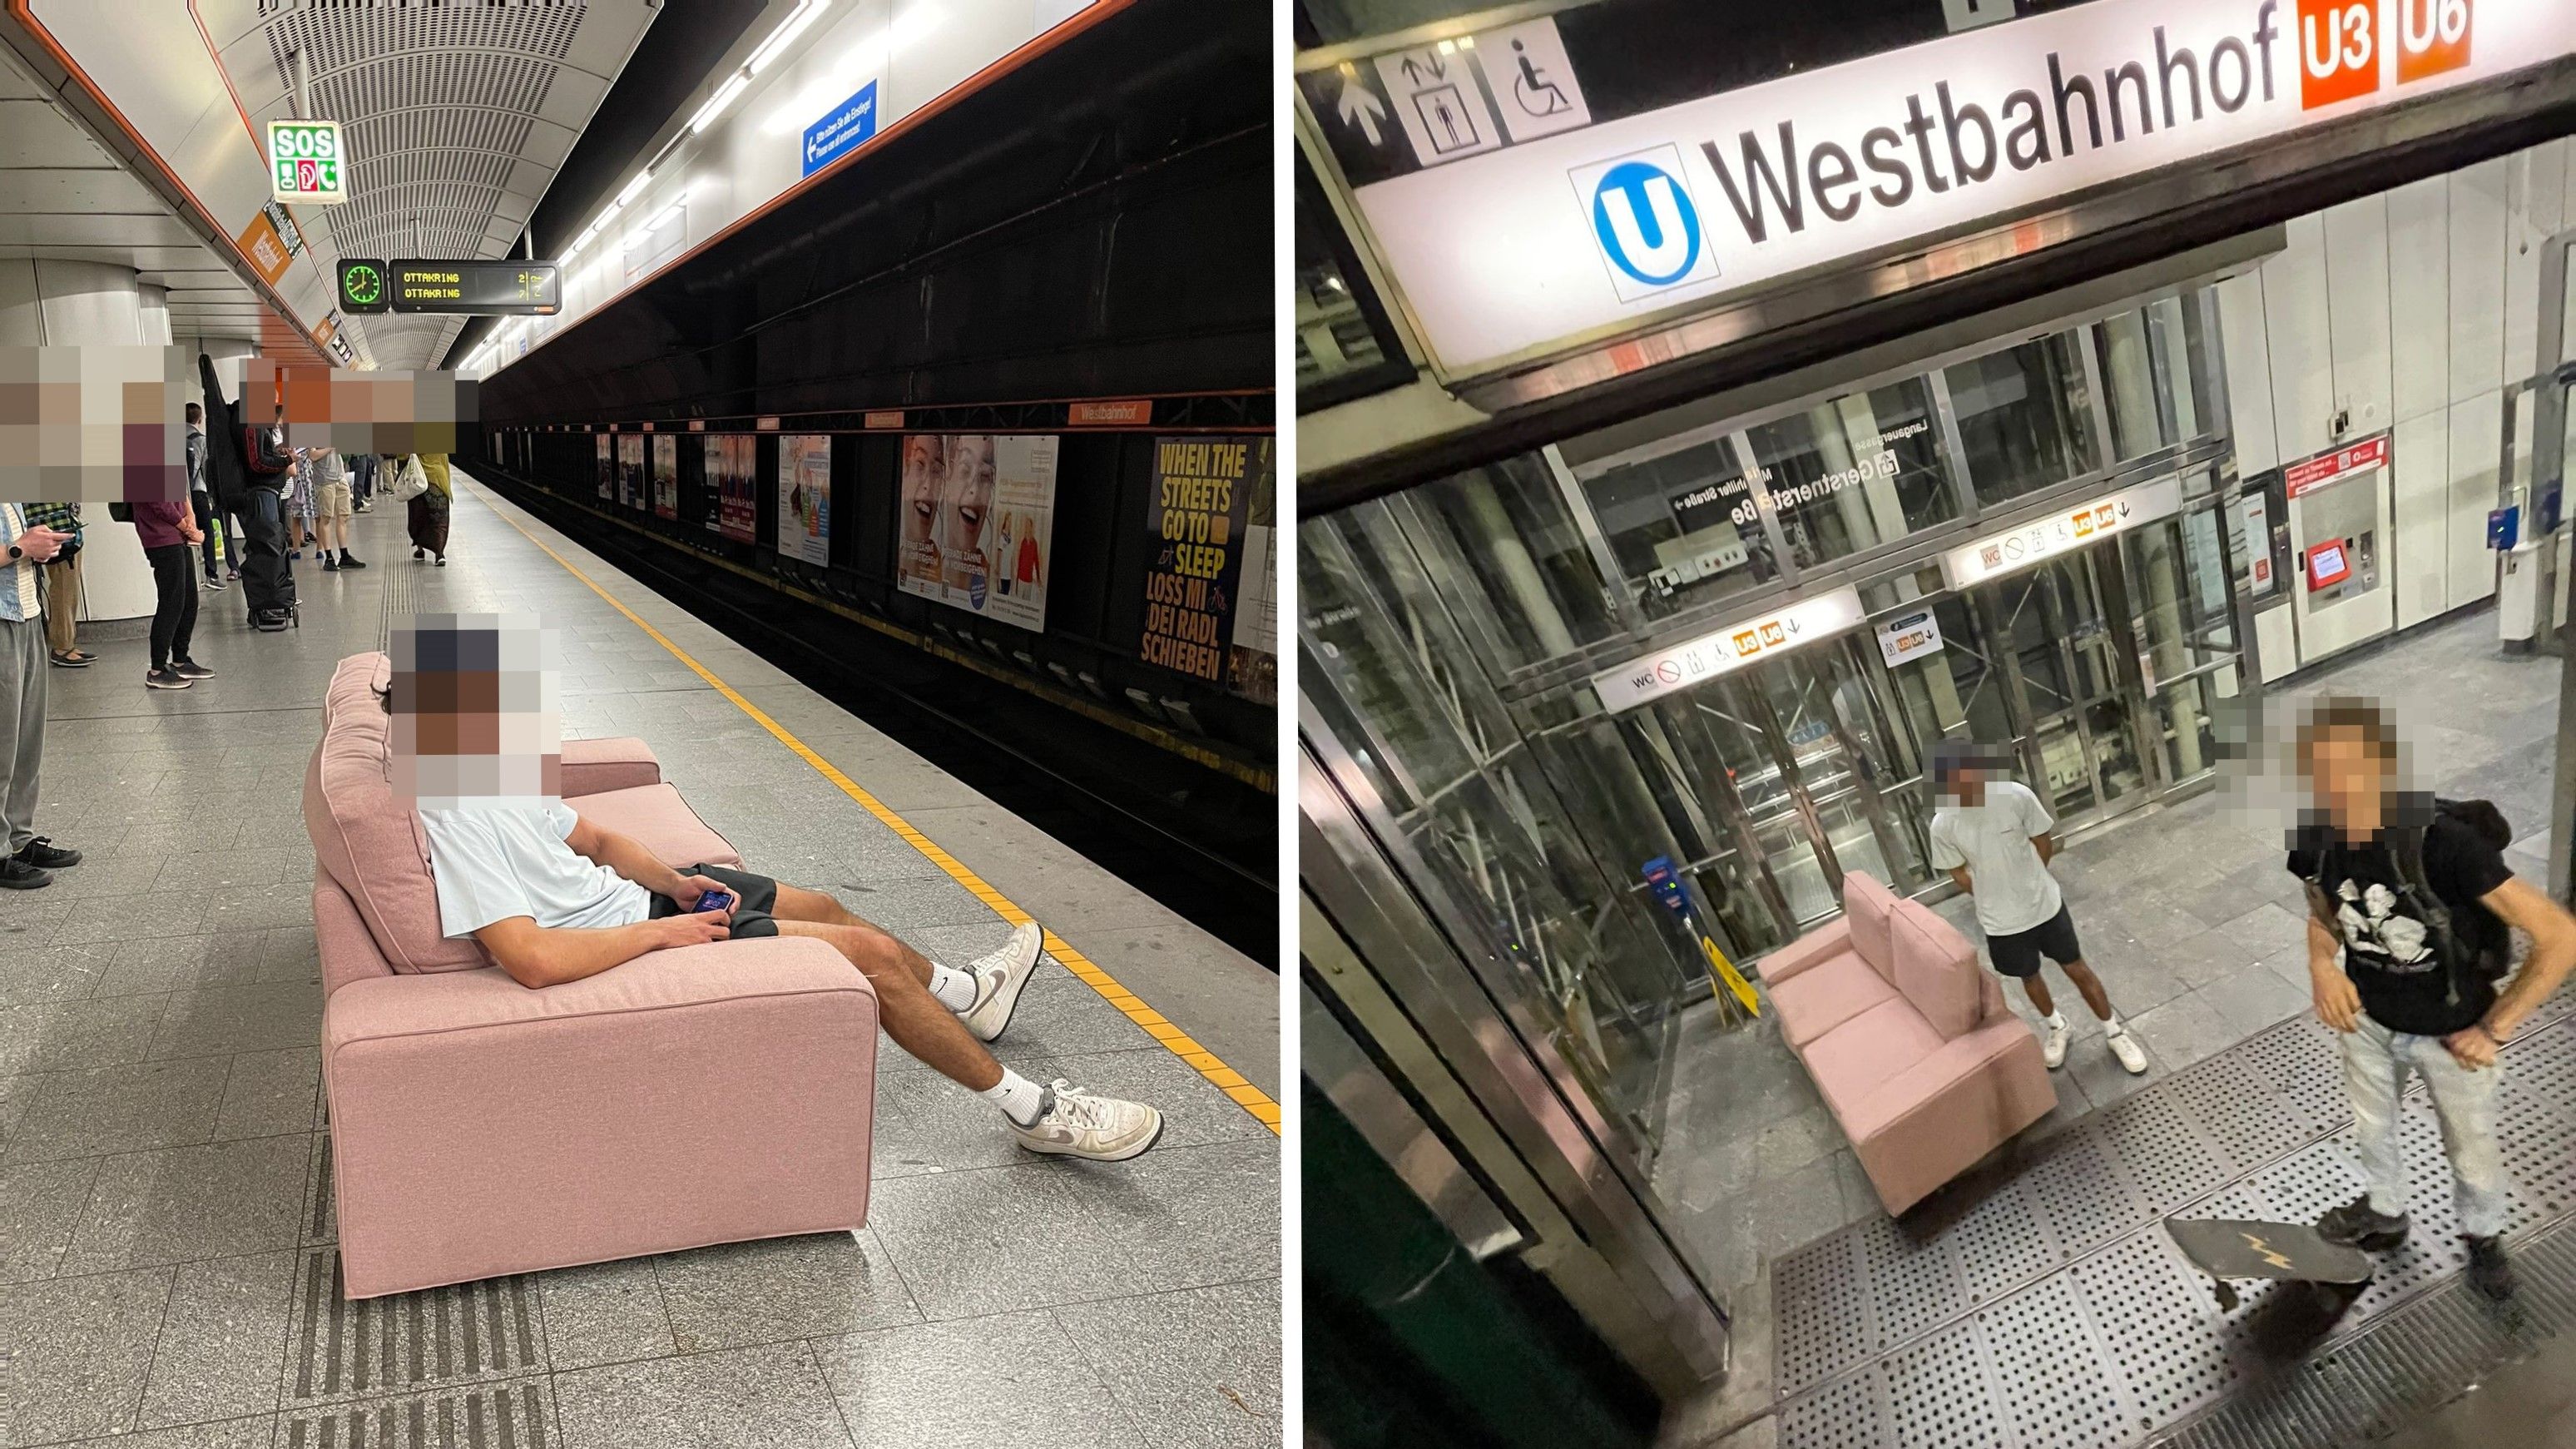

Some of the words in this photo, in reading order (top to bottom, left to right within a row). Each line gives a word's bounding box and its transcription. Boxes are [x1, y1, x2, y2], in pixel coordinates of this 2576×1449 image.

[276, 128, 334, 157] SOS
[1599, 176, 1690, 280] U
[1701, 0, 2279, 244] Westbahnhof
[2304, 3, 2372, 78] U3
[2402, 0, 2468, 54] U6
[404, 272, 460, 284] OTTAKRING
[404, 288, 461, 299] OTTAKRING
[1081, 404, 1137, 420] Westbahnhof
[1160, 444, 1210, 476] WHEN
[1212, 444, 1247, 478] THE
[1160, 476, 1232, 513] STREETS
[1162, 509, 1185, 541] GO
[1187, 512, 1209, 543] TO
[1982, 550, 2001, 564] WC
[2073, 518, 2093, 534] U3
[2095, 510, 2114, 525] U6
[1174, 543, 1226, 580] SLEEP
[1146, 571, 1184, 606] LOSS
[1186, 578, 1206, 611] MI
[1147, 603, 1176, 636] DEI
[1176, 608, 1218, 648] RADL
[1141, 632, 1221, 682] SCHIEBEN
[1632, 673, 1656, 689] WC
[1735, 635, 1760, 653] U3
[1761, 627, 1785, 644] U6
